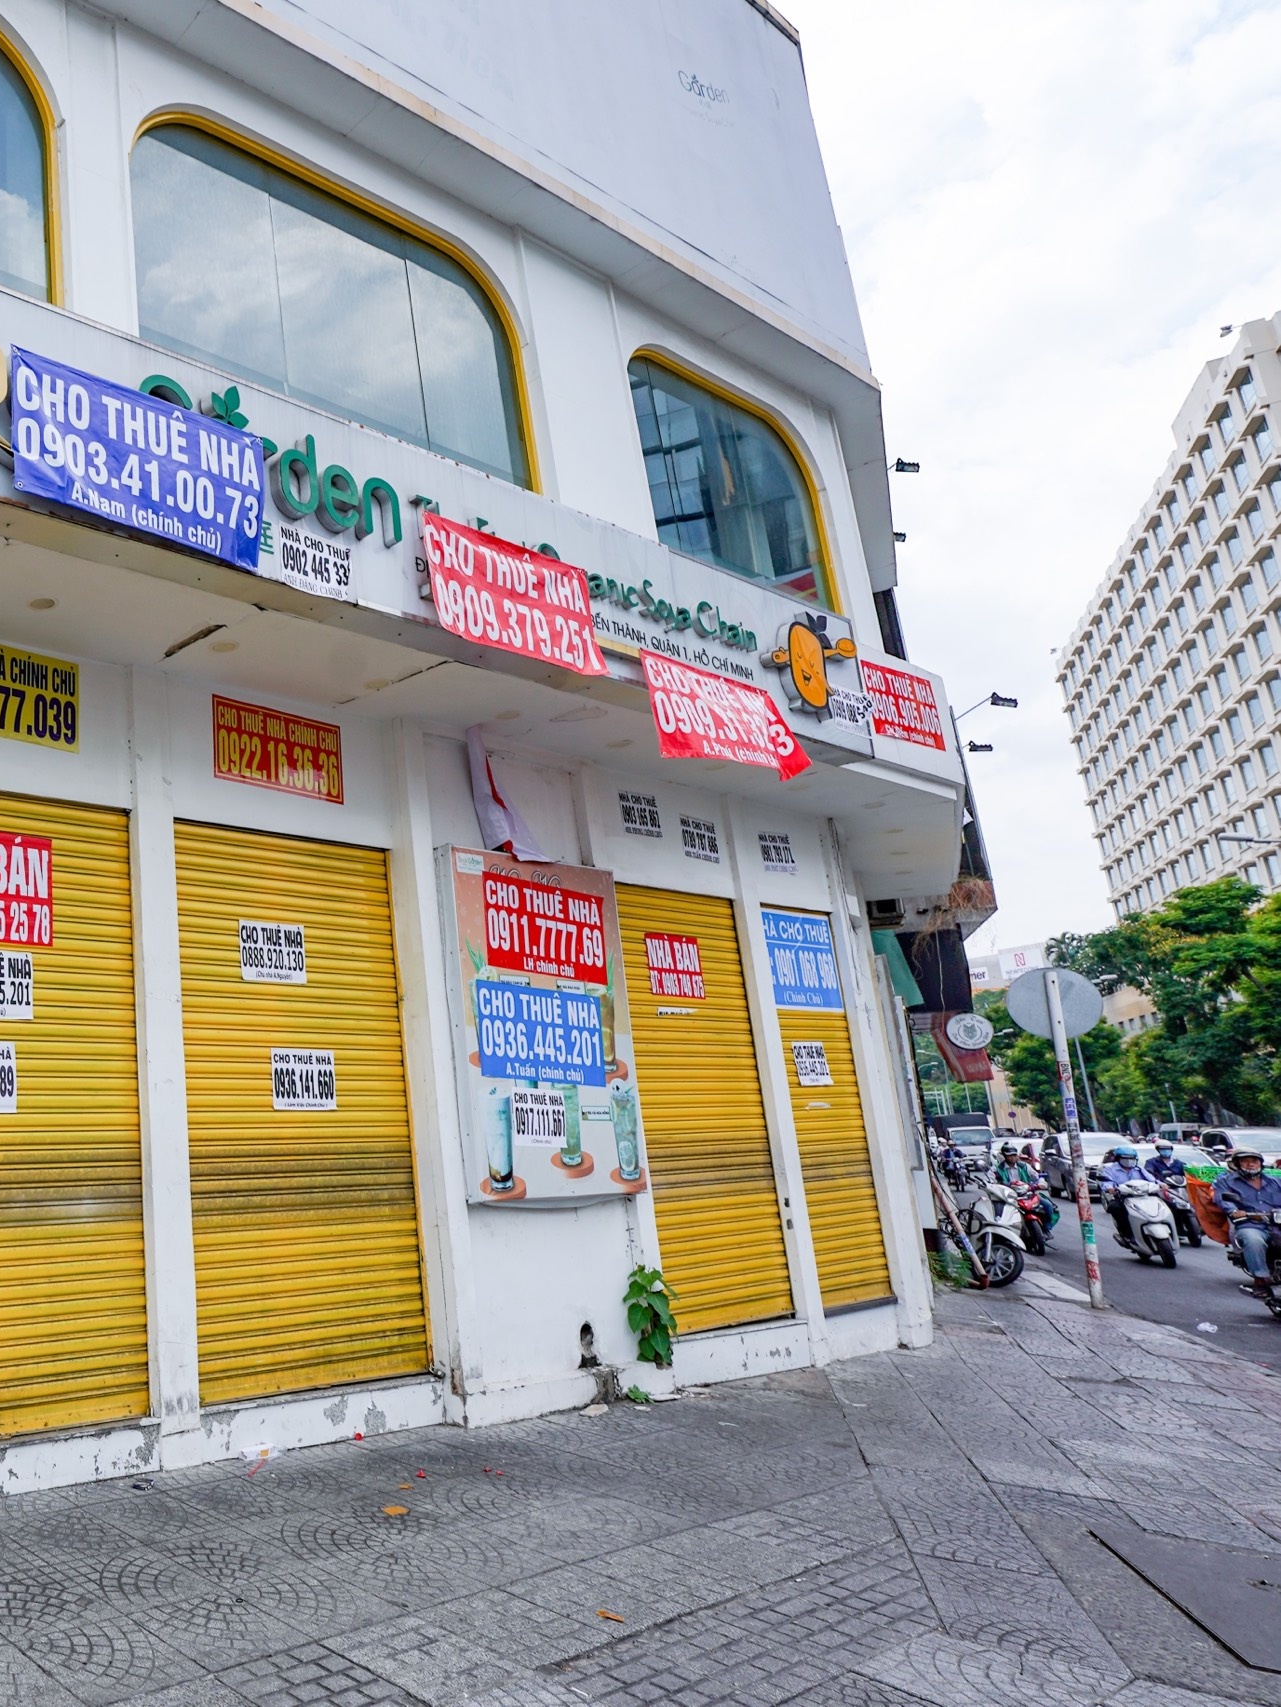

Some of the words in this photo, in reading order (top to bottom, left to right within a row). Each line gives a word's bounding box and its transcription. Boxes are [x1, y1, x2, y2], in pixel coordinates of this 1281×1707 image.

[16, 365, 91, 431] CHO
[101, 395, 189, 465] THUÊ
[198, 428, 261, 492] NHÀ
[17, 417, 260, 539] 0903.41.00.73
[71, 481, 126, 519] A.Nam
[131, 503, 183, 538] (chính
[187, 522, 222, 555] chủ)
[280, 526, 301, 545] NHÀ
[304, 536, 324, 553] CHO
[282, 542, 309, 577] 0902
[311, 554, 331, 584] 445
[424, 524, 475, 577] CHO
[479, 554, 539, 600] THUÊ
[542, 567, 588, 616] NHÀ
[434, 573, 602, 671] 0909.379.251
[612, 619, 649, 648] THÀNH,
[651, 636, 680, 658] QUẬN
[693, 648, 710, 667] HỒ
[711, 656, 730, 673] CHÍ
[731, 662, 754, 681] MINH
[10, 656, 49, 691] CHÍNH
[52, 665, 76, 697] CHỦ
[644, 656, 692, 695] CHO
[863, 666, 886, 692] CHO
[886, 673, 914, 699] THUÊ
[913, 680, 935, 706] NHÀ
[703, 739, 733, 758] A.Phú
[735, 745, 767, 763] (chính
[9, 900, 29, 943] 25
[33, 904, 50, 945] 78
[485, 880, 519, 909] CHO
[523, 890, 565, 919] THUÊ
[567, 898, 601, 927] NHÀ
[241, 925, 259, 945] CHO
[261, 925, 282, 947] THUÊ
[284, 927, 303, 949] NHÀ
[487, 908, 604, 968] 0911.7777.69
[779, 921, 803, 940] CHO
[804, 922, 829, 943] THUÊ
[8, 954, 32, 980] NHÀ
[242, 946, 304, 972] 0888.920.130
[523, 957, 534, 970] LH
[536, 960, 558, 976] chính
[560, 963, 575, 978] chủ
[646, 935, 674, 969] NHÀ
[673, 937, 700, 972] BÁN
[479, 988, 515, 1018] CHO
[520, 993, 563, 1025] THUÊ
[567, 997, 600, 1029] NHÀ
[273, 1053, 290, 1064] CHO
[292, 1052, 313, 1065] THUÊ
[315, 1053, 332, 1066] NHÀ
[481, 1018, 601, 1067] 0936.445.201
[274, 1068, 334, 1100] 0936.141.660
[506, 1062, 536, 1075] A.Tuấn
[538, 1065, 564, 1079] (chính
[566, 1067, 584, 1084] chủ)
[514, 1092, 528, 1104] CHO
[530, 1092, 548, 1105] THUÊ
[549, 1095, 563, 1106] NHÀ
[515, 1107, 566, 1137] 0917.111.661
